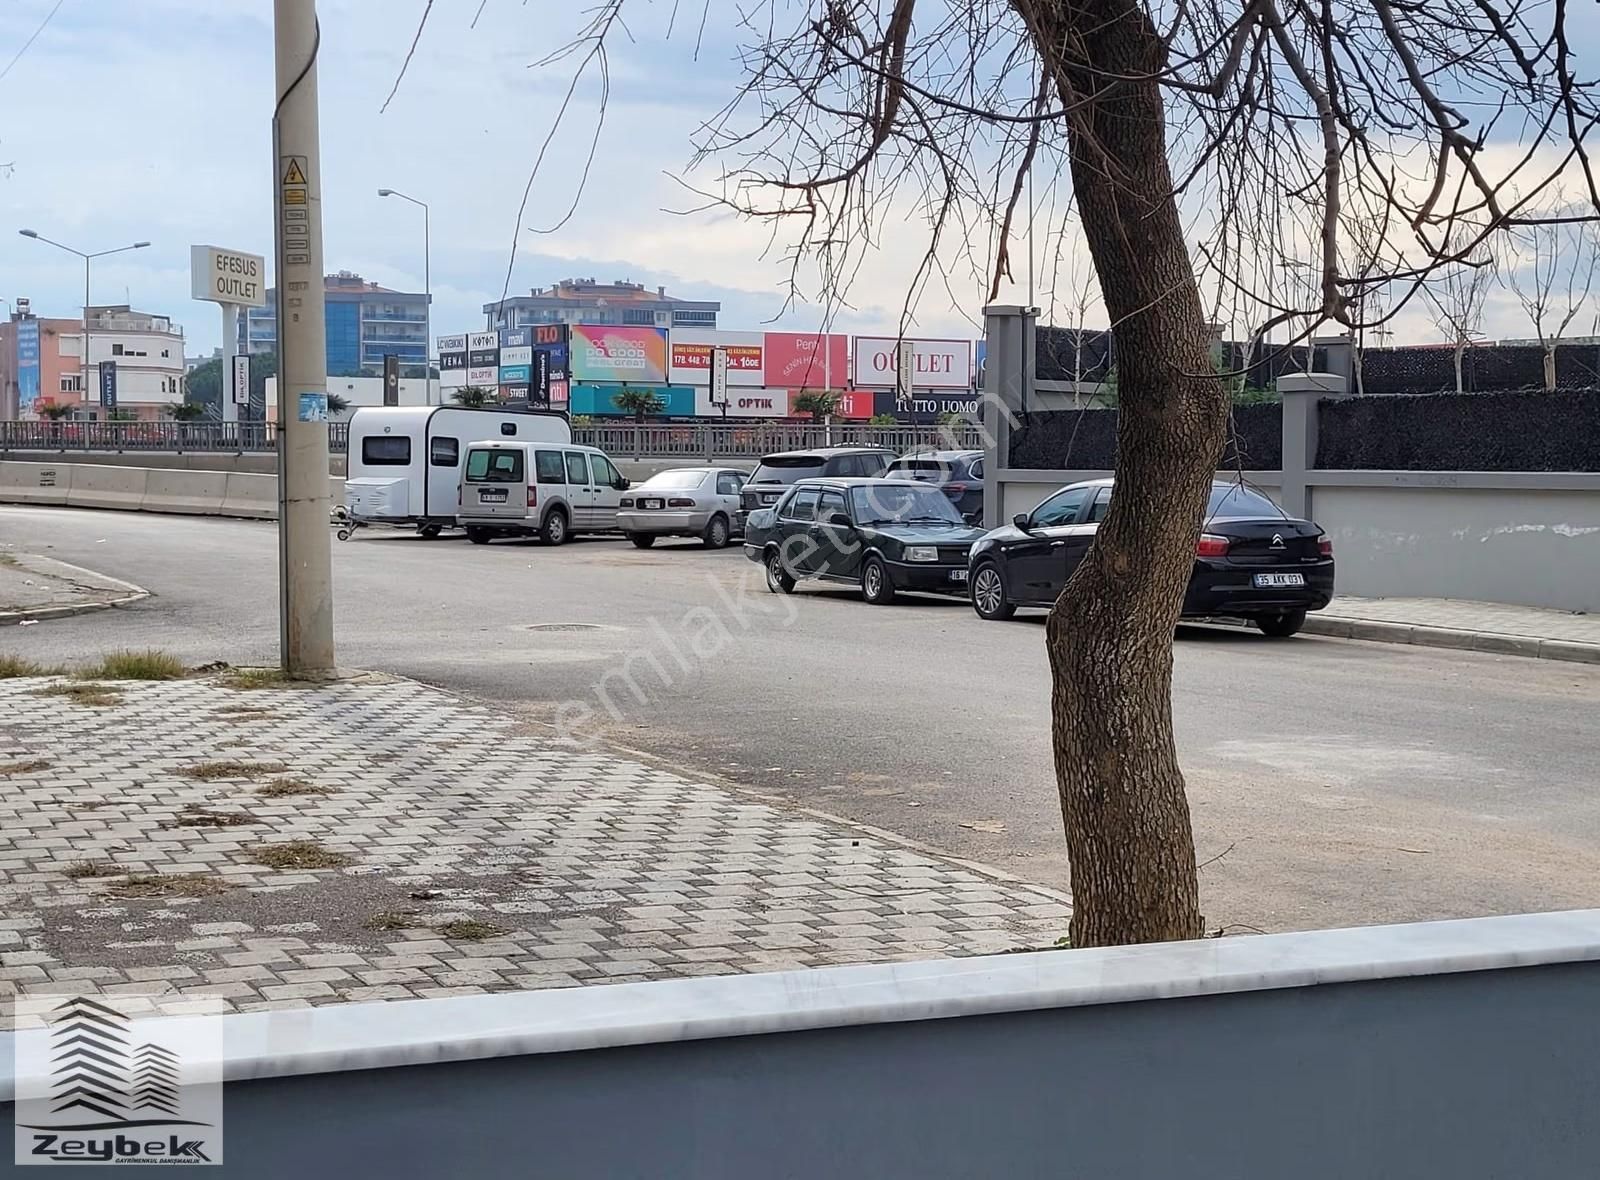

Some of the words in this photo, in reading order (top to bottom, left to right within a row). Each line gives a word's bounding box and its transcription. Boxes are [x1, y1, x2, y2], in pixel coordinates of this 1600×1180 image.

[216, 254, 257, 277] EFESUS
[216, 277, 257, 299] OUTLET
[537, 326, 558, 343] FLO
[608, 348, 646, 358] GOOD
[509, 388, 528, 398] STREET
[941, 400, 978, 413] UOMO
[1259, 575, 1269, 585] 35
